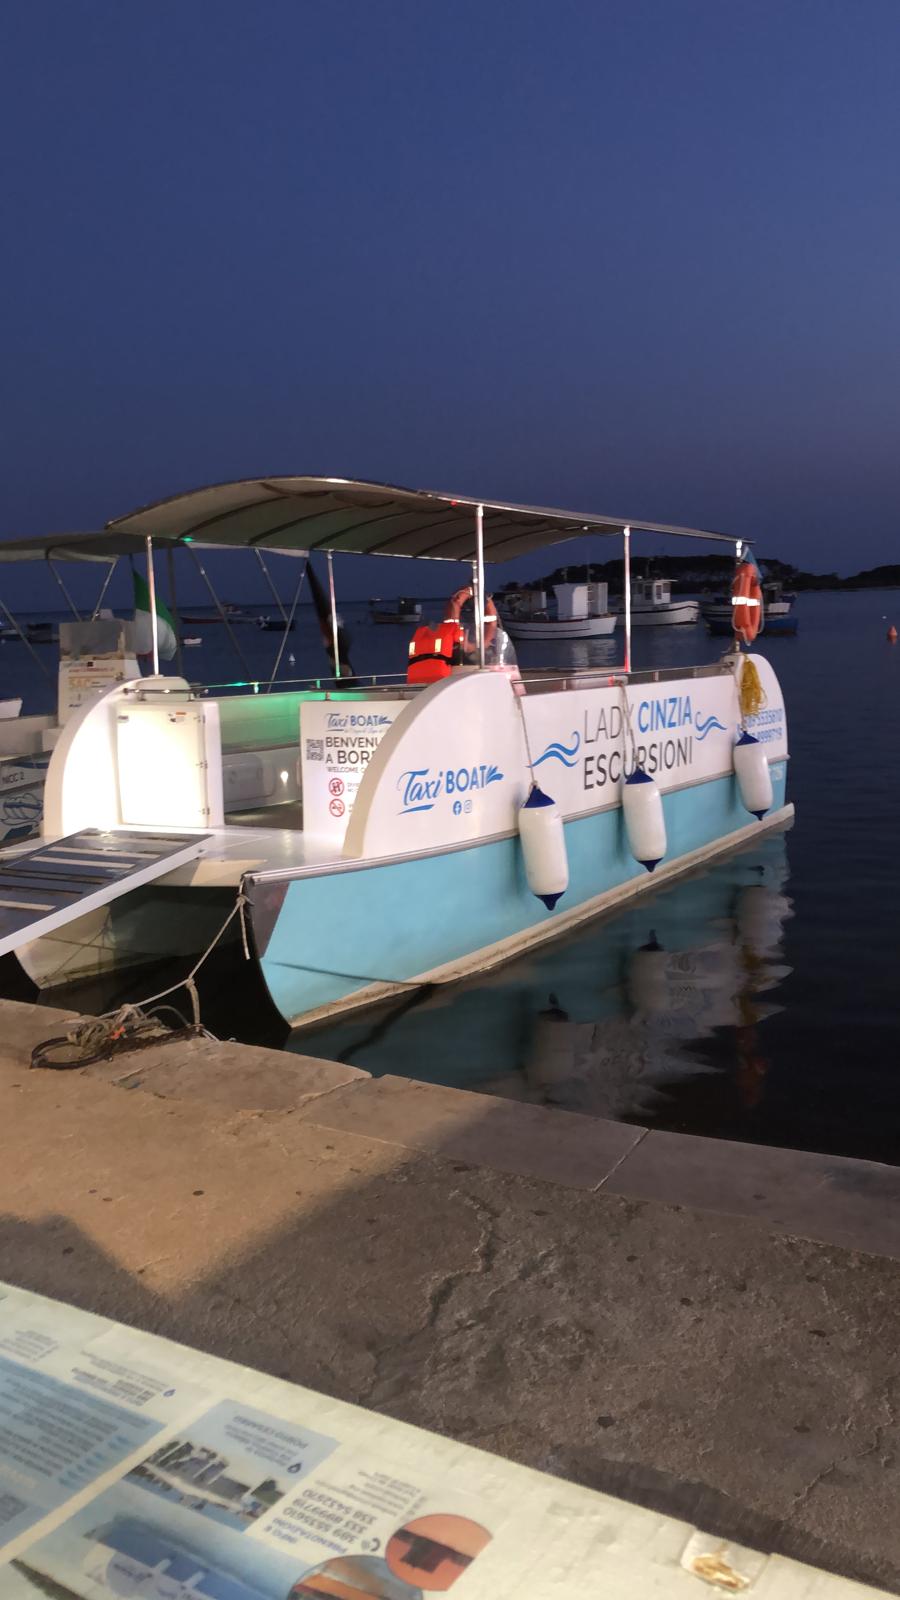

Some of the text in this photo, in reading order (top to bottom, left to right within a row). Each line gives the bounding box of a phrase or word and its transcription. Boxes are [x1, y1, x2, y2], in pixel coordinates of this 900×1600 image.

[325, 713, 379, 728] Taxi BOAT
[584, 695, 692, 743] LADY CINZIA
[325, 750, 375, 764] A BOR
[583, 736, 692, 790] ESCURSIONI
[397, 765, 487, 807] Taxi BOAT
